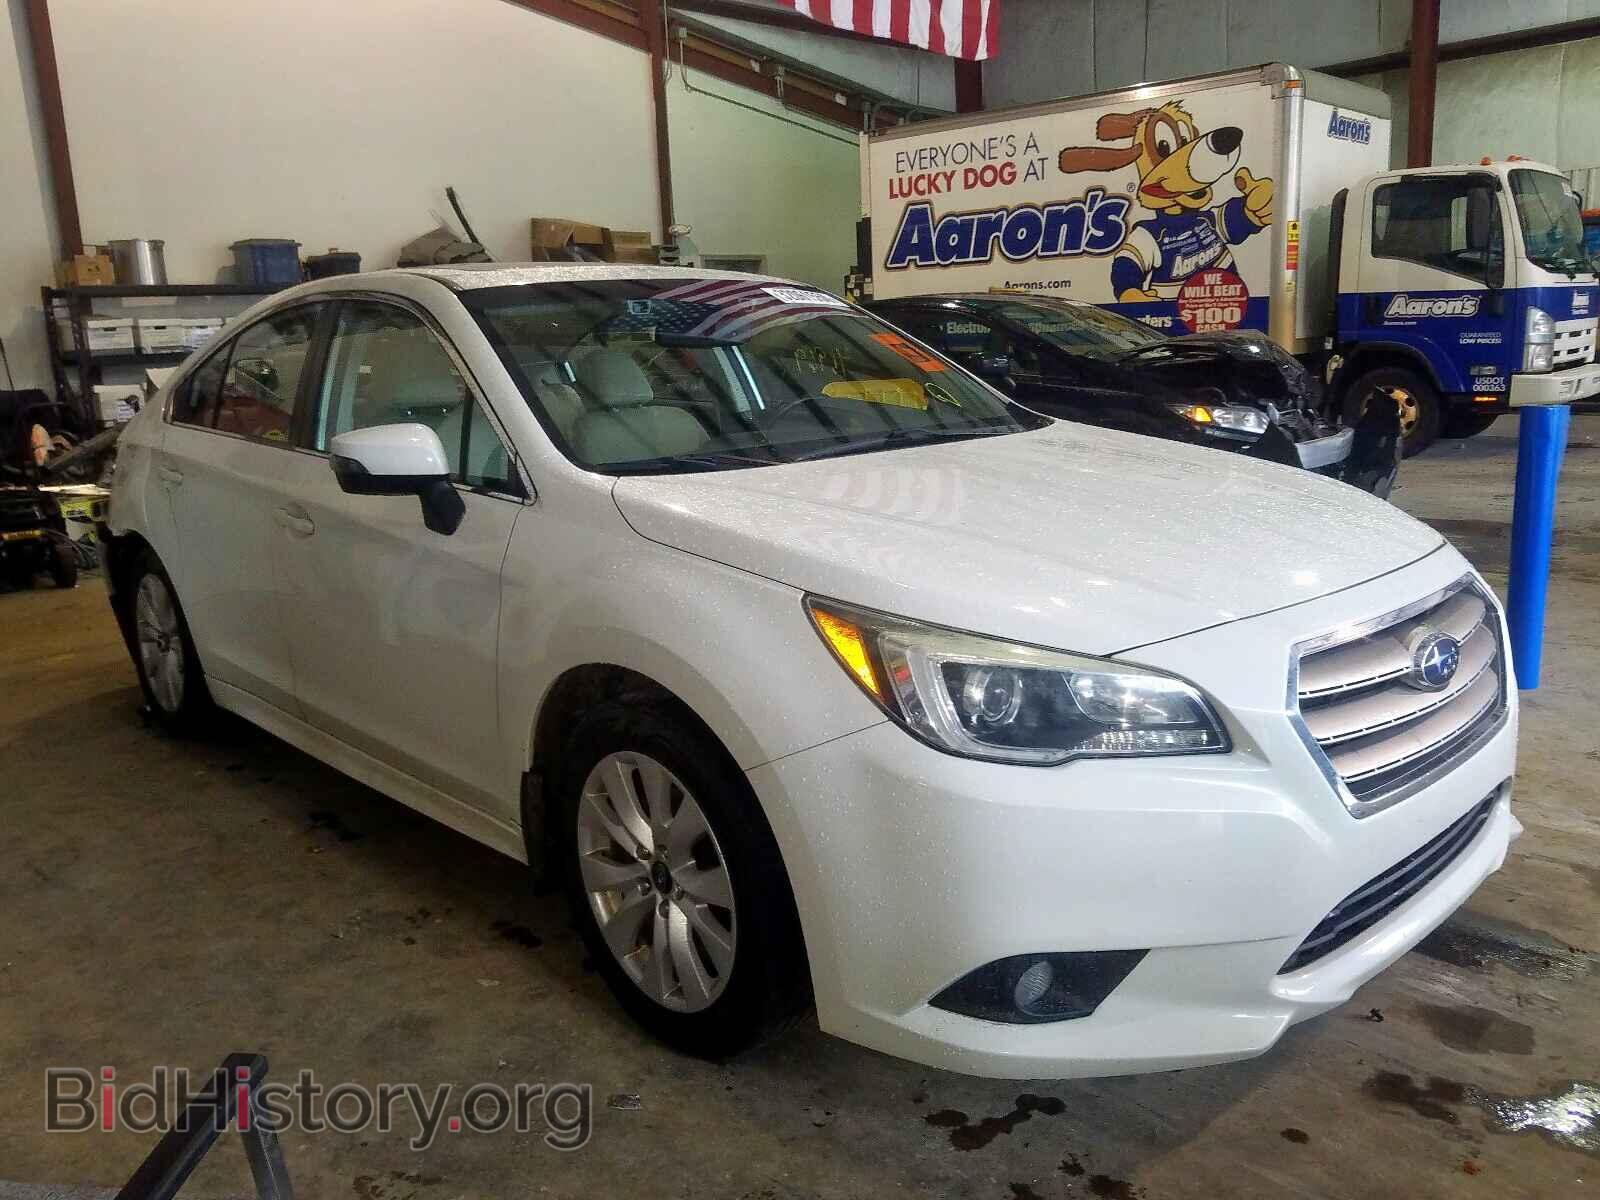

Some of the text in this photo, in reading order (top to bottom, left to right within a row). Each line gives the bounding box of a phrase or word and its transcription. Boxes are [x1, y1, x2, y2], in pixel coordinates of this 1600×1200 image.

[1327, 107, 1371, 145] Aaron's
[895, 132, 1040, 173] EVERYONE'S A
[888, 157, 1048, 200] LUCKY DOG AT
[886, 189, 1131, 270] Aaron's
[1004, 279, 1072, 290] Aarons.com
[1204, 273, 1223, 285] WE
[1184, 284, 1242, 298] WILL BEAT
[1181, 307, 1241, 324] $100
[1384, 294, 1480, 318] Aaron's
[1475, 377, 1505, 385] USDOT
